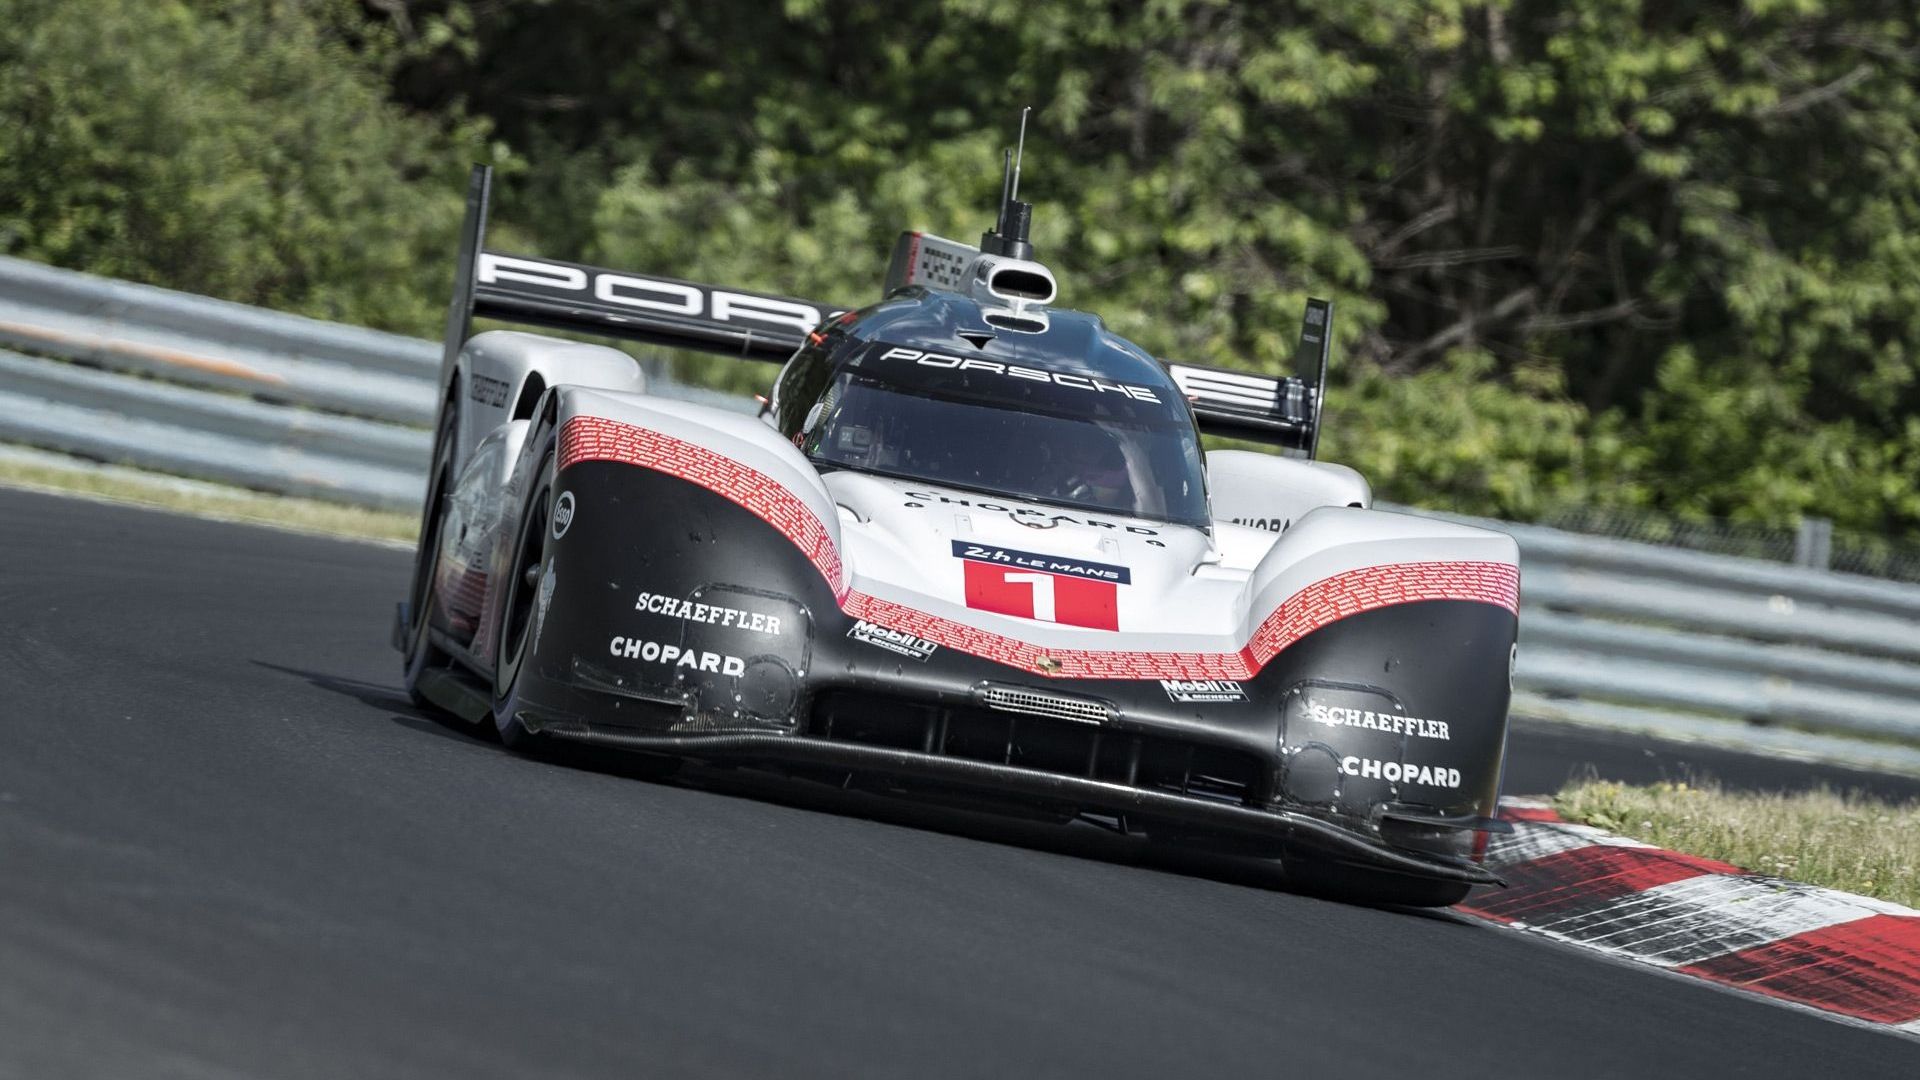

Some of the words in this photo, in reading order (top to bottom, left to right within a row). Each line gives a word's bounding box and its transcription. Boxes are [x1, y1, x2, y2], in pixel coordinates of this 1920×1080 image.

[478, 253, 846, 335] POR
[880, 347, 1162, 404] PORSCHE
[905, 491, 1159, 536] CHOPARD
[1016, 557, 1045, 568] LE
[1050, 562, 1119, 580] MANS
[635, 592, 781, 635] SCHAEFFLER
[1004, 572, 1056, 623] 1
[853, 619, 916, 646] Mobil
[610, 636, 745, 677] CHOPARD
[1160, 680, 1222, 692] Mobil
[1312, 704, 1450, 741] SCHAEFFLER
[1341, 756, 1461, 789] CHOPARD
